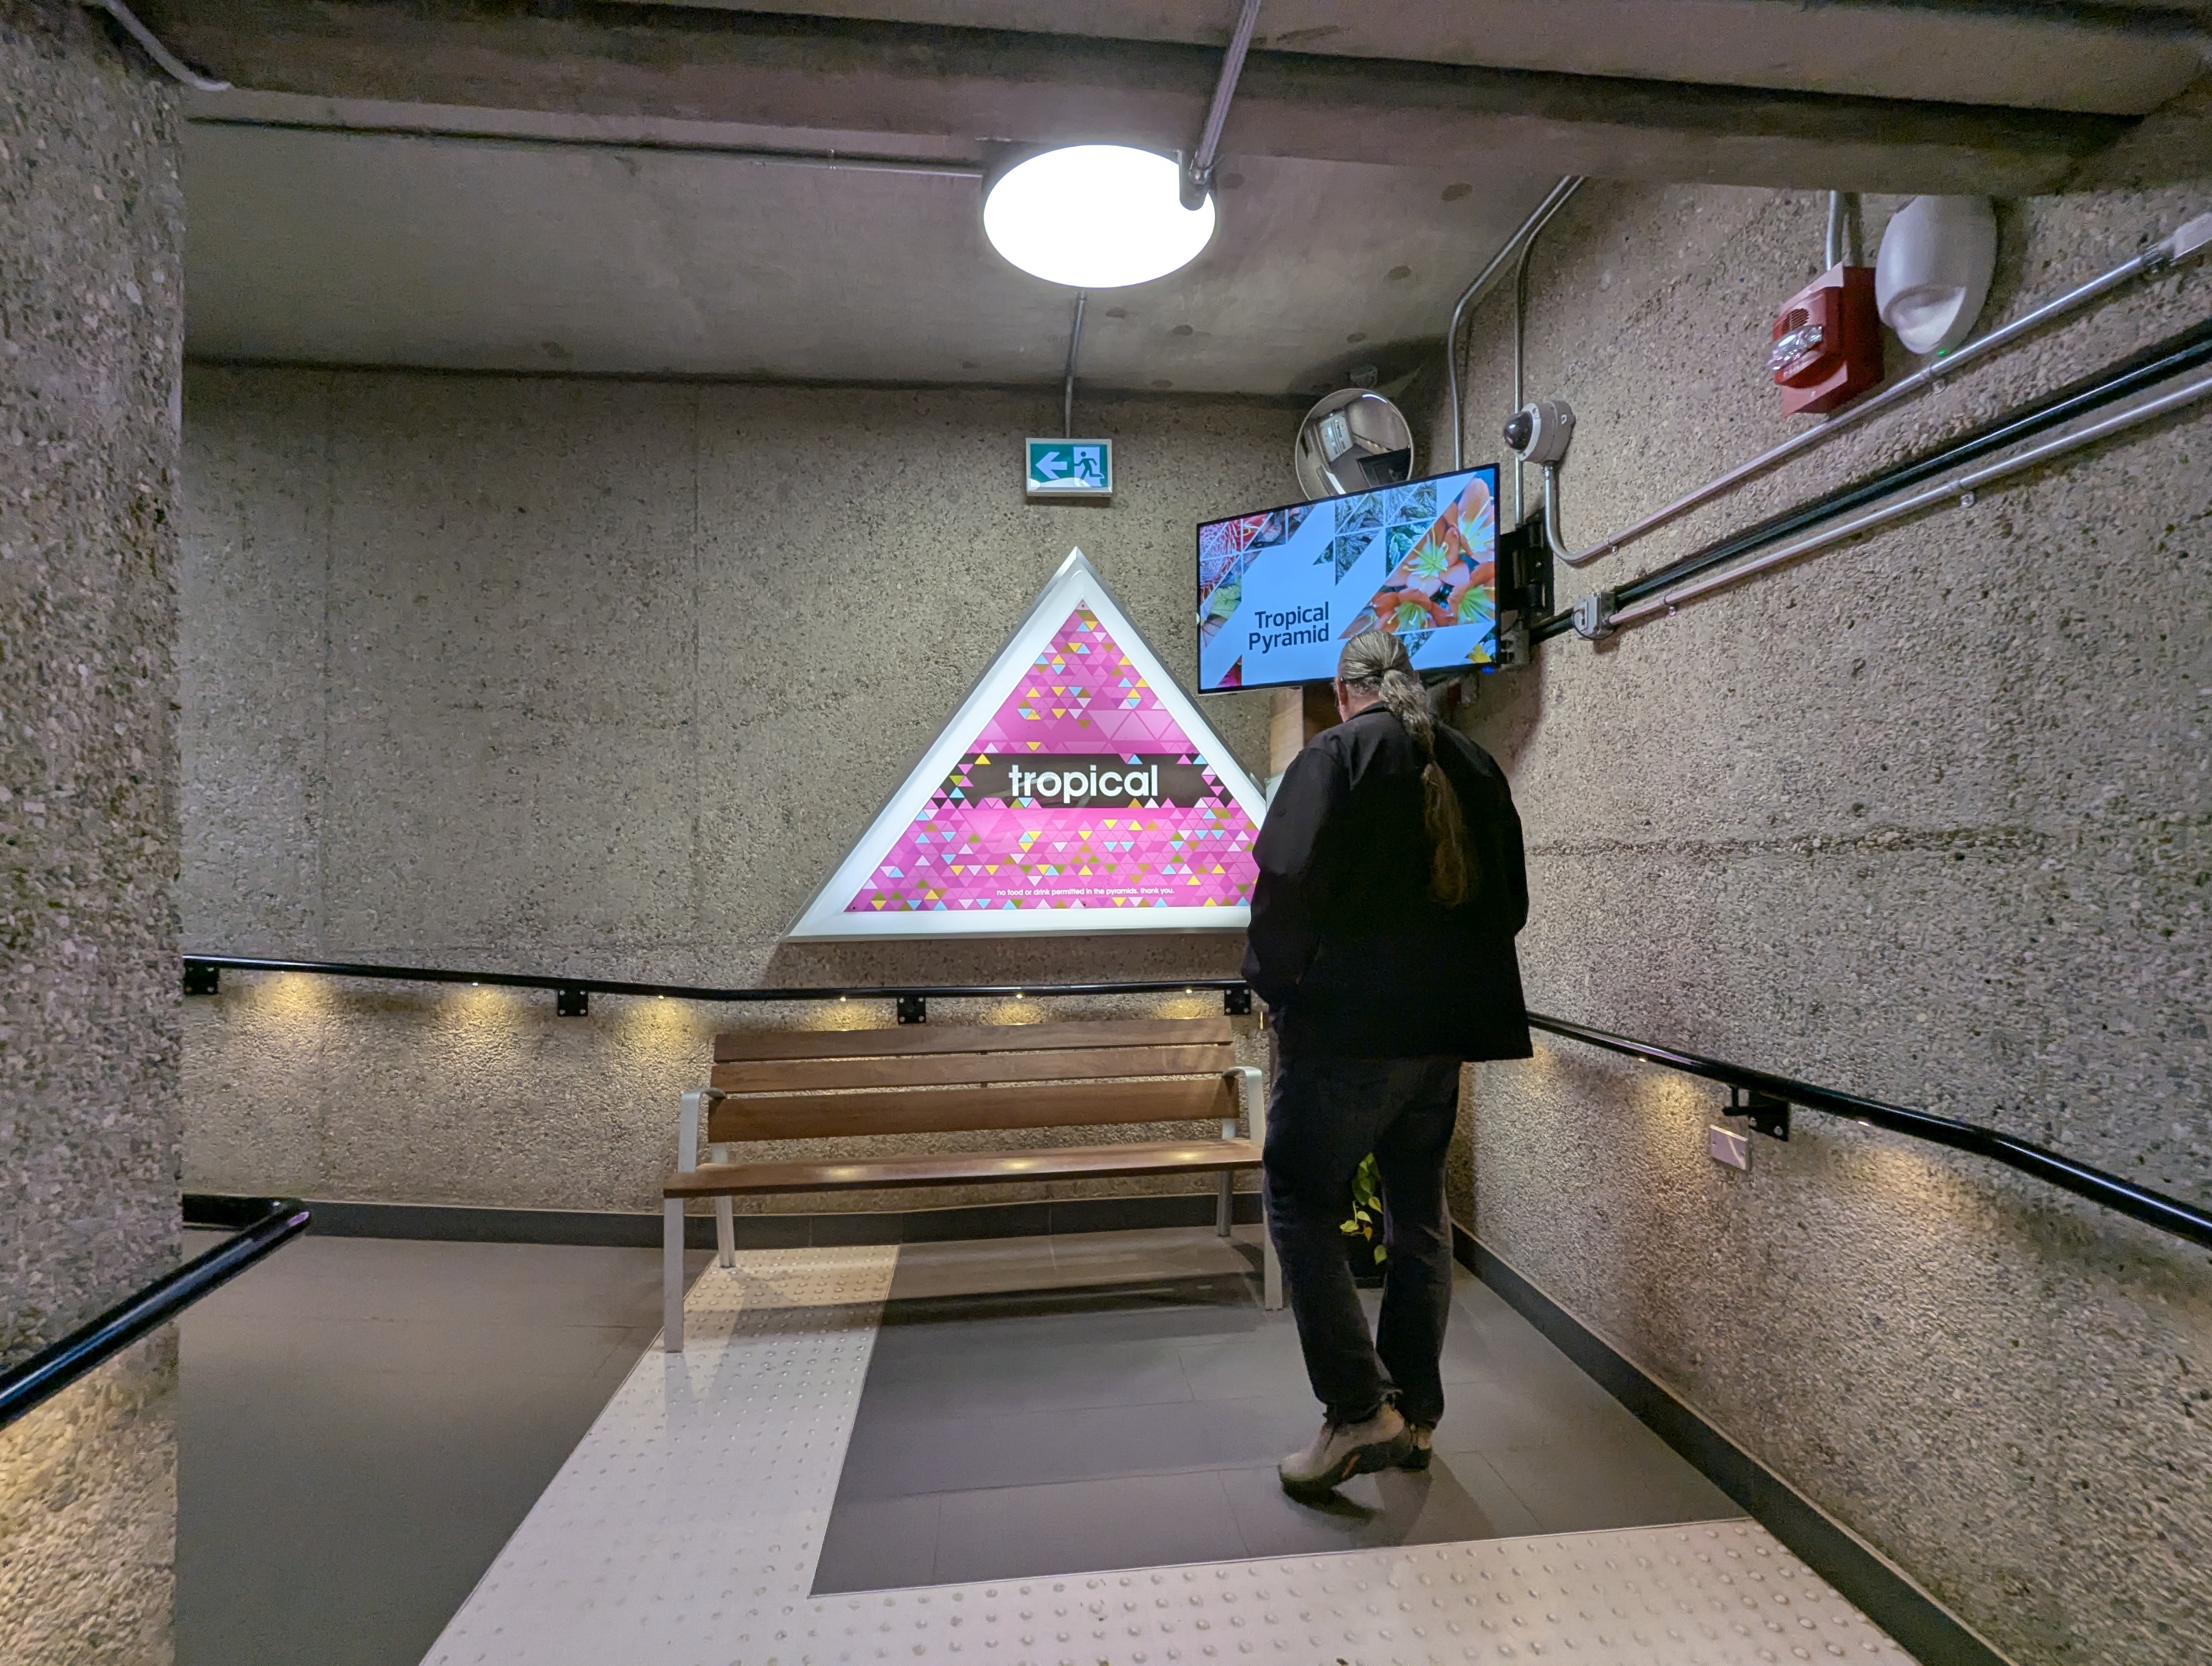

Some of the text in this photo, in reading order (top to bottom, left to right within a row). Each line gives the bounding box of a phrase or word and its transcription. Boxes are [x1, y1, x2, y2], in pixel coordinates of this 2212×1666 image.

[1255, 601, 1329, 630] Tropical
[1249, 623, 1329, 654] Pyramid
[1008, 765, 1158, 804] tropical
[1106, 887, 1139, 895] pyramids.
